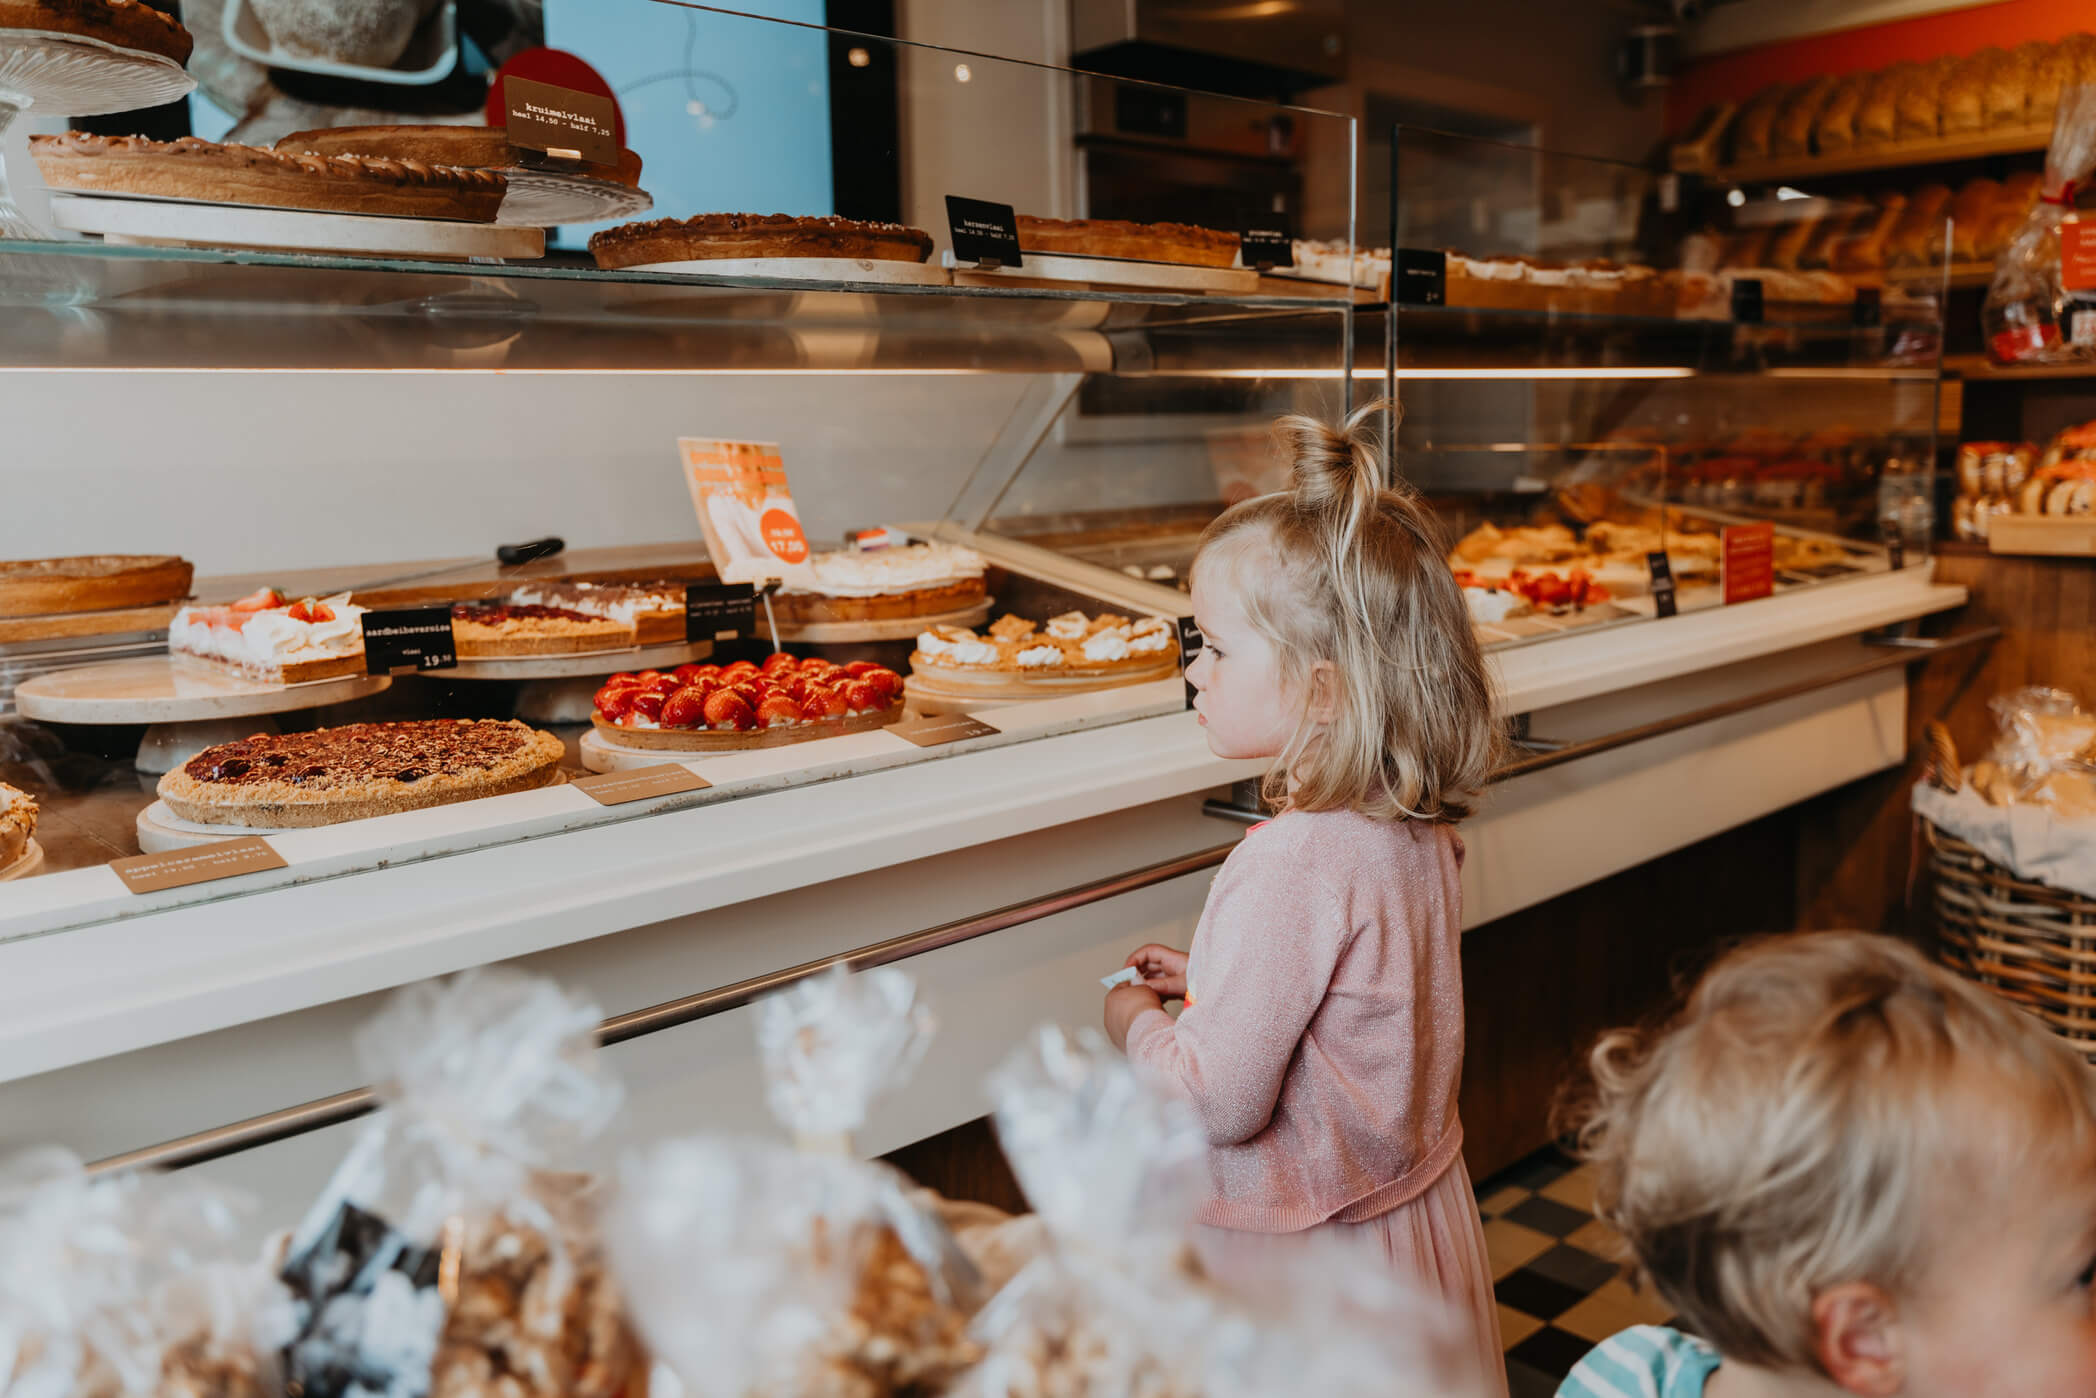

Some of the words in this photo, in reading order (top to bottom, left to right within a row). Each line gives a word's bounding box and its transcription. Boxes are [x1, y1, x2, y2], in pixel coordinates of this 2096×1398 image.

[512, 110, 531, 119] heel
[571, 122, 588, 132] half
[526, 103, 596, 125] kruimelvlaai
